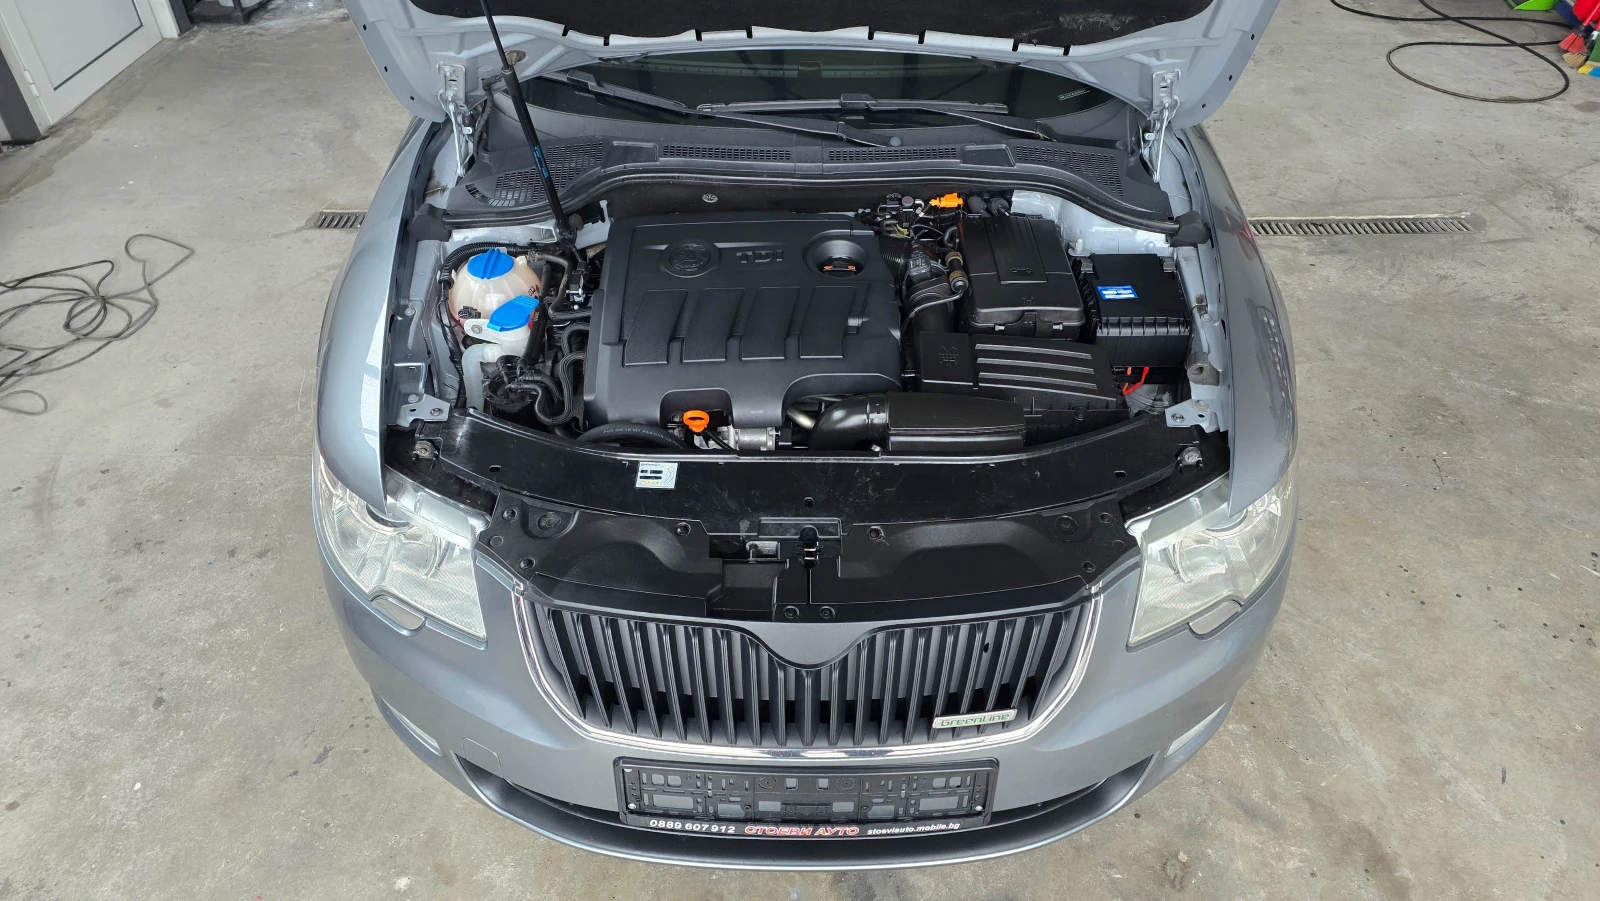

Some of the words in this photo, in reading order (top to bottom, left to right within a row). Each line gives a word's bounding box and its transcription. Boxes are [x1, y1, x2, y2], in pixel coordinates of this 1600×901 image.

[736, 250, 783, 263] TDI
[650, 819, 682, 830] 0889
[685, 821, 709, 832] 607
[711, 824, 736, 834] 912
[867, 822, 961, 836] stoeviauto.mobile.bg
